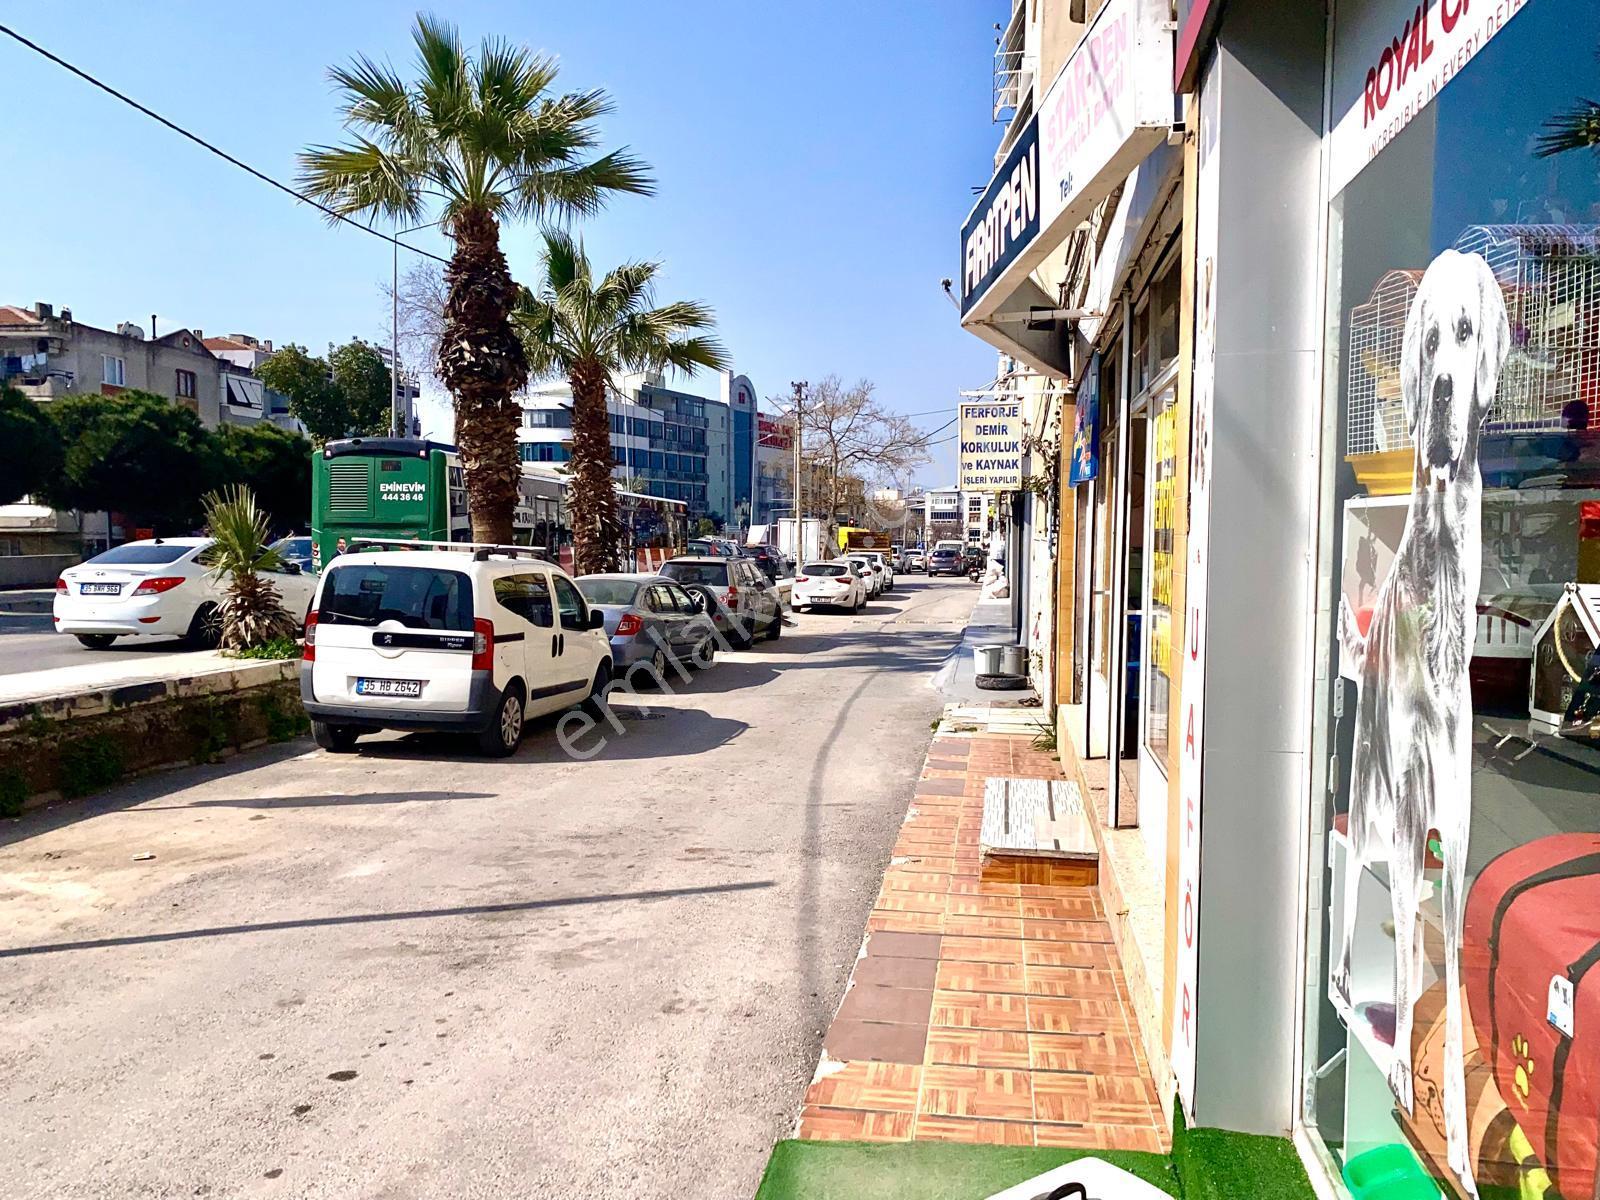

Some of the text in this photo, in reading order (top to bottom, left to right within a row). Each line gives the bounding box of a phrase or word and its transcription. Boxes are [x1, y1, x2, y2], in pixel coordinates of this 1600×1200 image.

[1363, 0, 1434, 129] ROYAL
[1367, 91, 1424, 162] INCREDIBLE
[1426, 74, 1438, 102] IN
[1442, 28, 1481, 86] EVERY
[1059, 171, 1073, 202] Tel:
[965, 142, 1036, 298] FIRATPEN
[965, 406, 1019, 418] FERFORJE
[975, 422, 1008, 436] DEMİR
[961, 441, 1019, 453] KORKULUK
[961, 459, 1019, 470] ve KAYNAK
[963, 475, 1018, 485] İŞLERİ YAPILIR
[379, 481, 426, 493] EMİNEVİM
[381, 493, 399, 501] 444
[364, 680, 418, 693] 35 HB 2642
